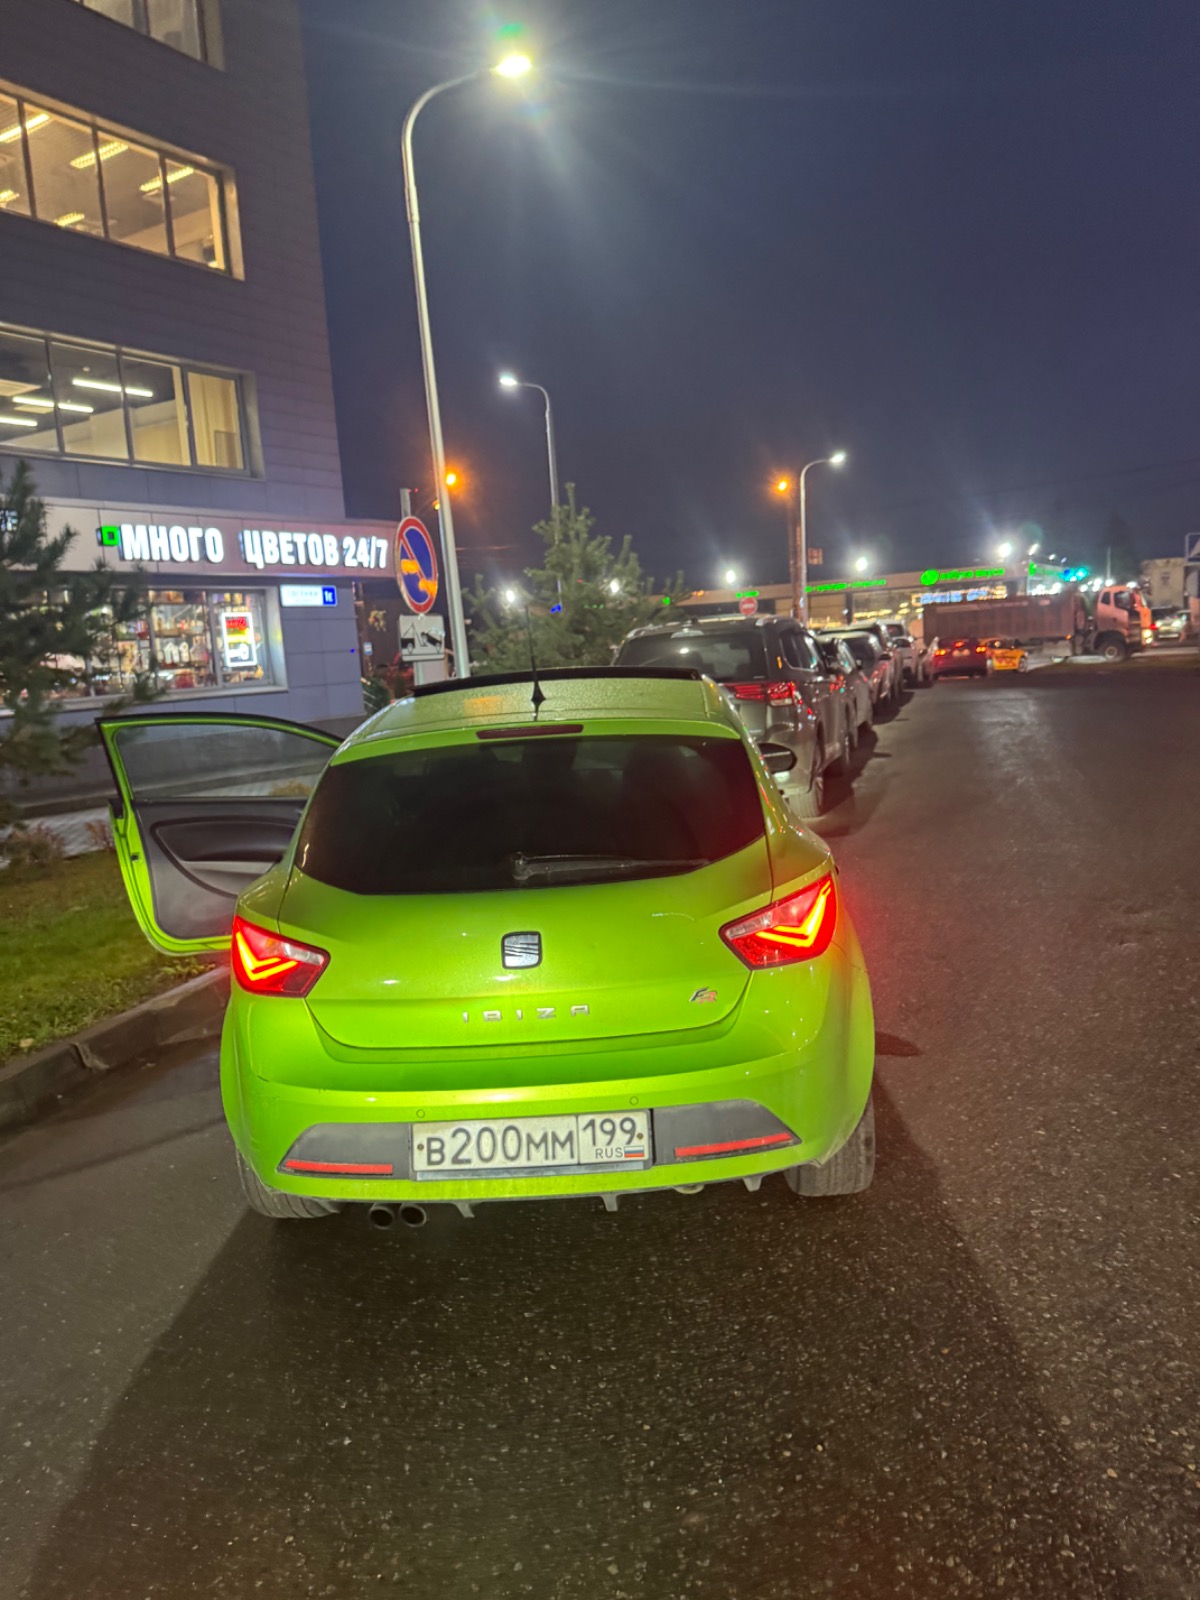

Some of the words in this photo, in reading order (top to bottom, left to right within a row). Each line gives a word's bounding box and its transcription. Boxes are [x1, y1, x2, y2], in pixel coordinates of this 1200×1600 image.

[120, 523, 224, 563] МНОГО
[241, 530, 339, 569] ЦВЕТОВ
[342, 535, 389, 569] 24/7
[461, 1004, 590, 1023] IBIZA
[582, 1116, 637, 1147] 199
[594, 1147, 624, 1159] RUS
